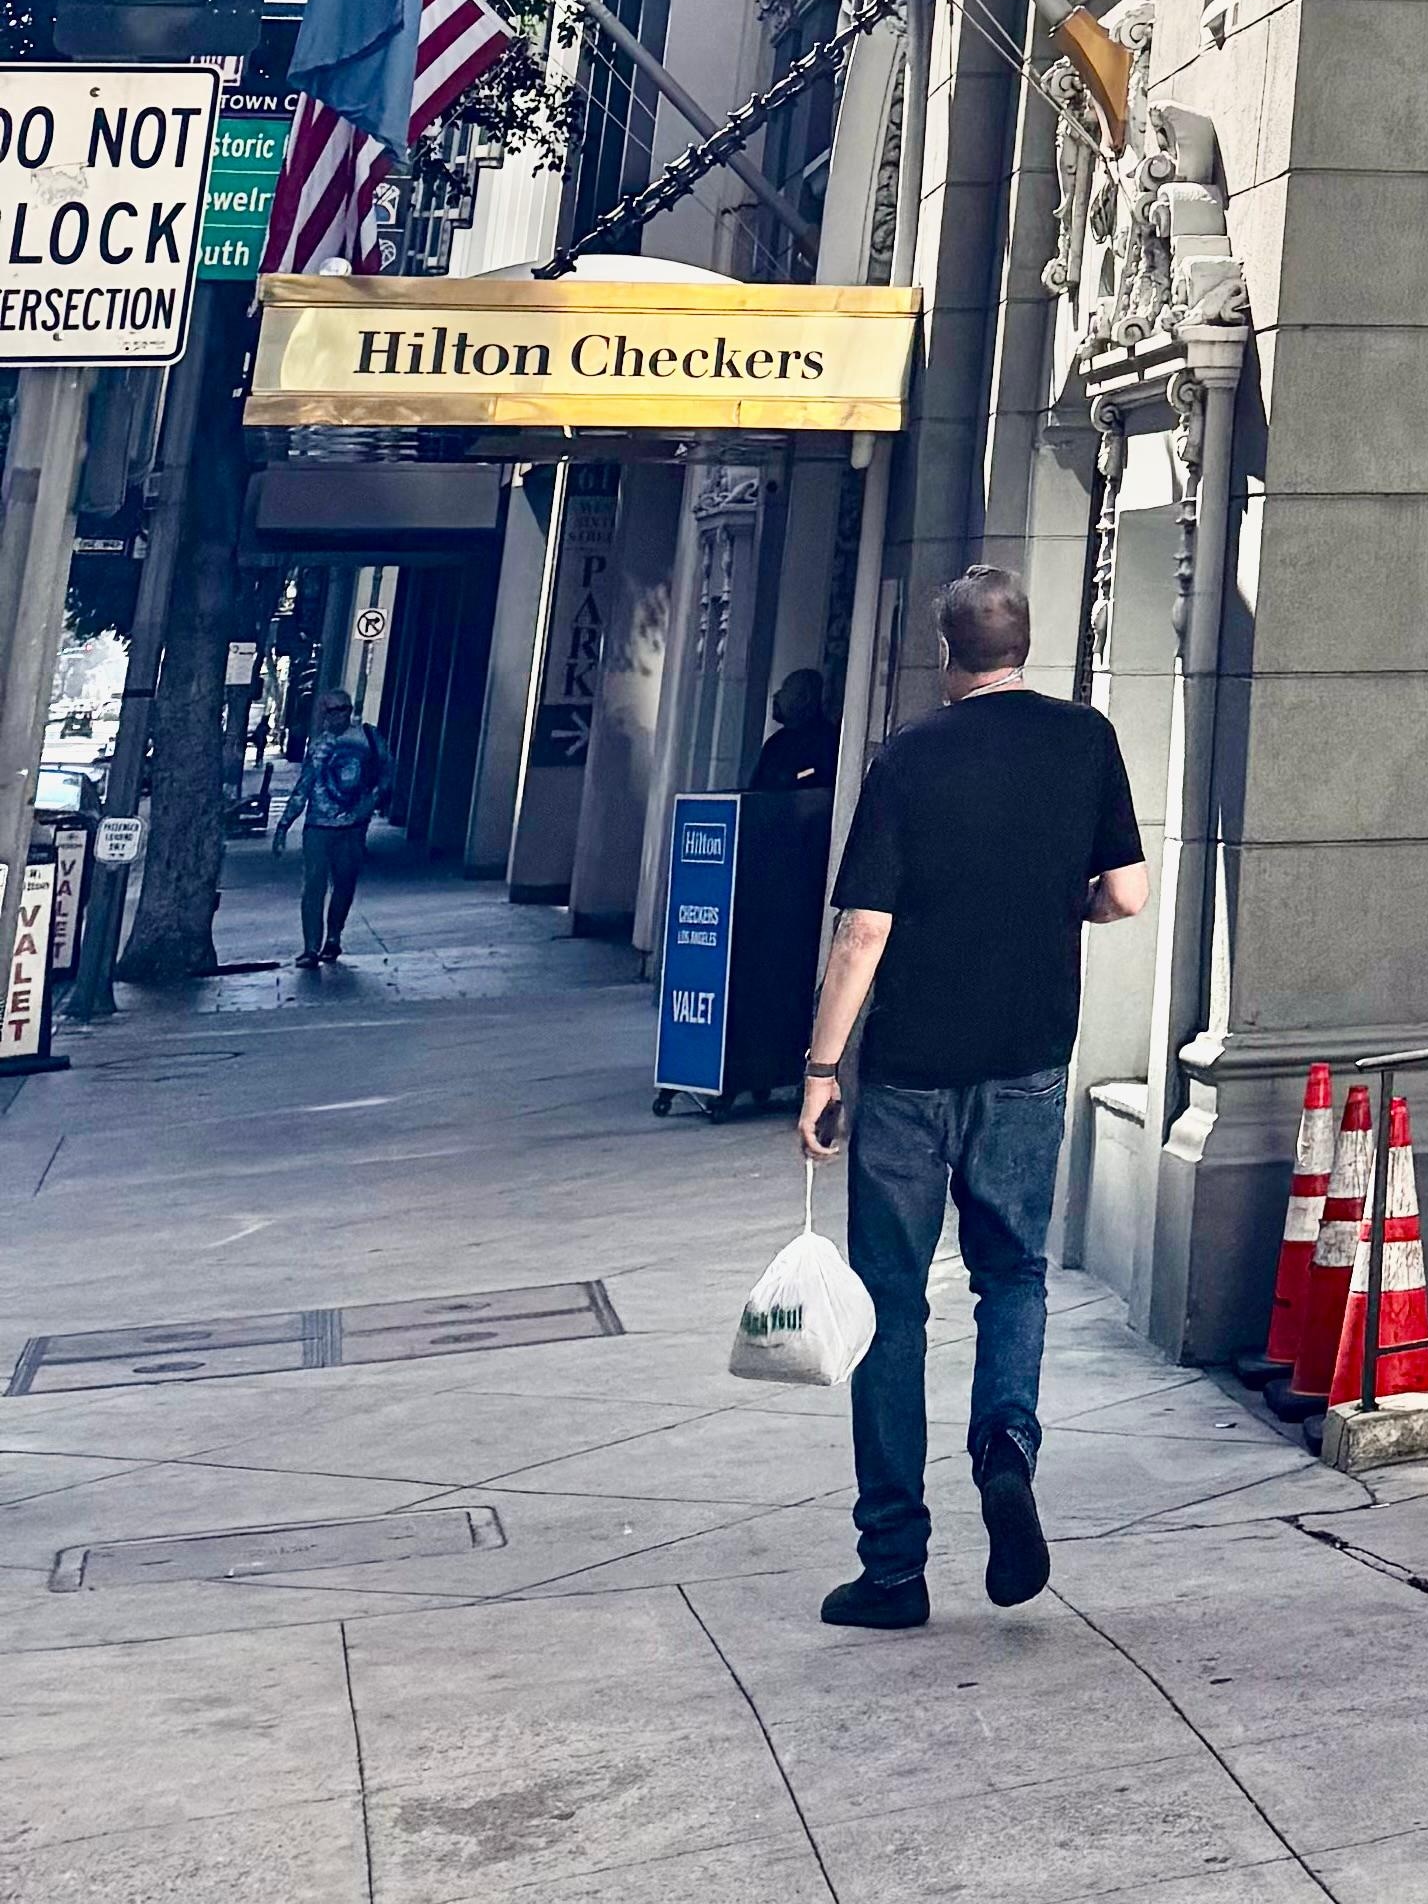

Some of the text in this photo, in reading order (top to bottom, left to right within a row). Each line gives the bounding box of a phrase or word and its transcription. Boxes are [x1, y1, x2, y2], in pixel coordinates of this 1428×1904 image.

[87, 107, 203, 168] NOT
[204, 186, 276, 213] ewelr
[0, 201, 187, 265] LOCK
[200, 240, 250, 267] uth
[0, 287, 176, 331] ERSECTION
[353, 327, 825, 380] Hilton Checkers
[563, 555, 607, 697] PARK
[685, 831, 722, 856] Hilton
[53, 859, 77, 959] VALET
[679, 905, 719, 925] CHECKERS
[8, 904, 42, 1042] VALET
[672, 990, 715, 1025] VALET
